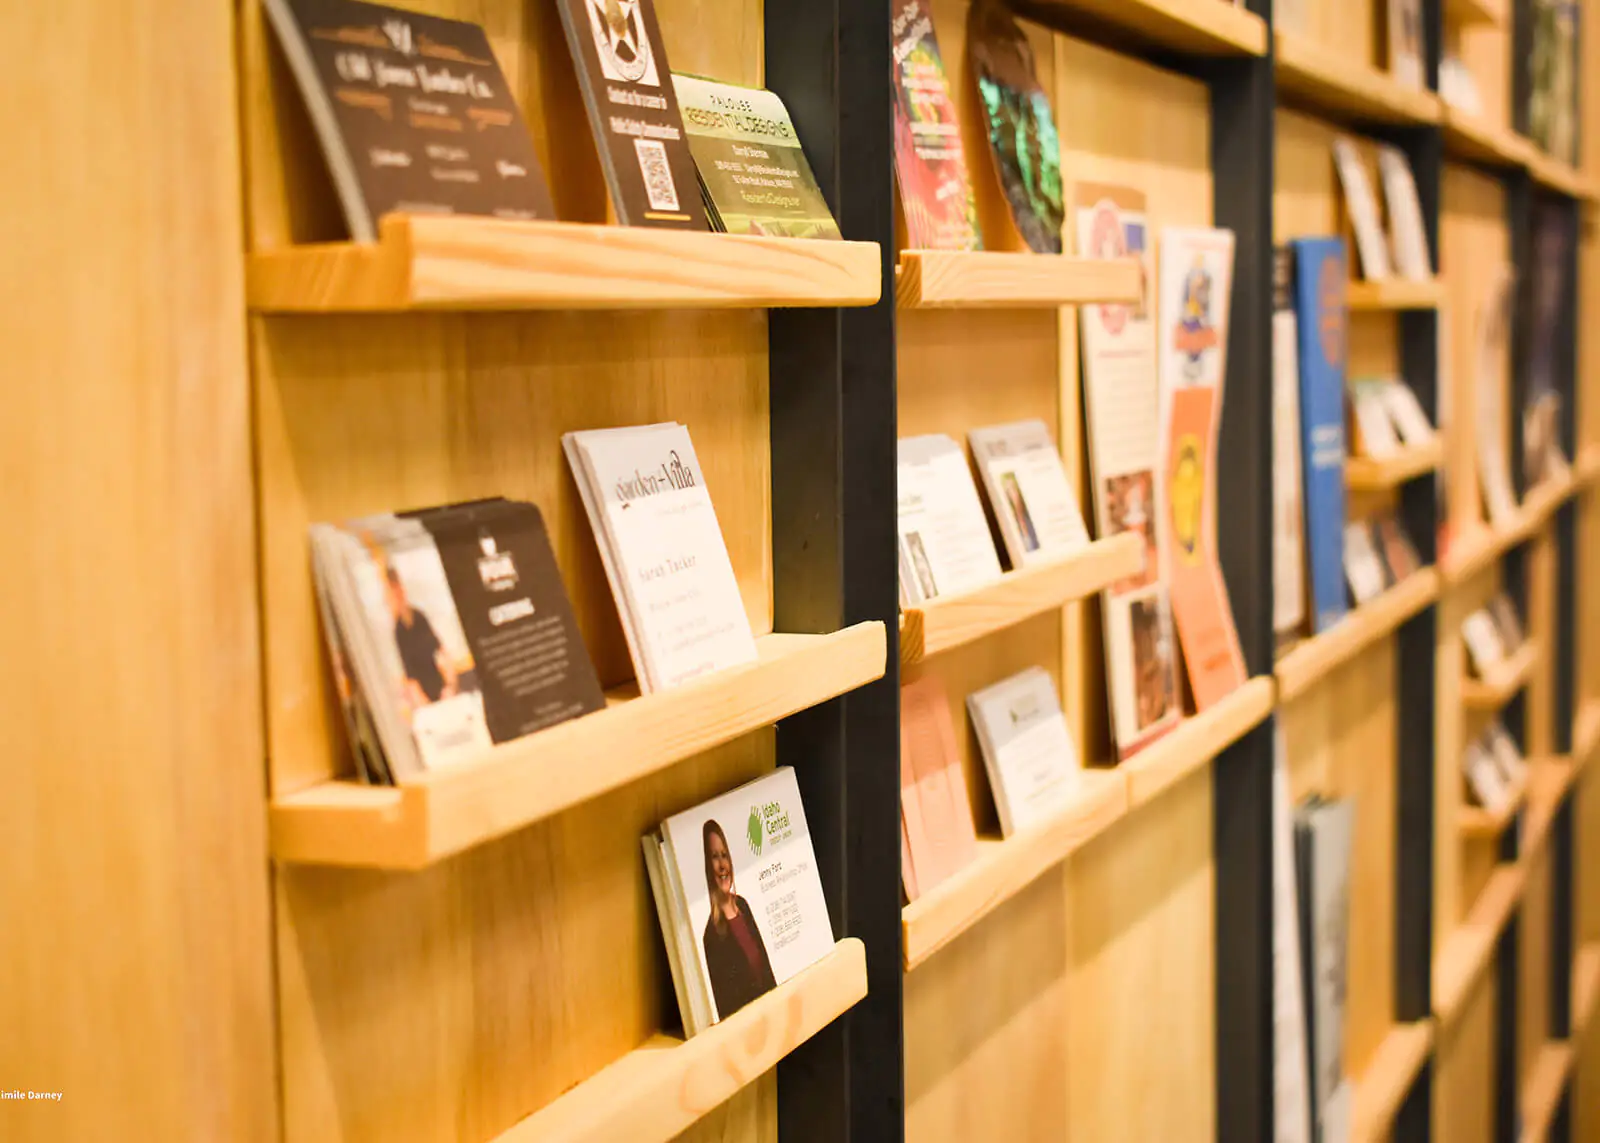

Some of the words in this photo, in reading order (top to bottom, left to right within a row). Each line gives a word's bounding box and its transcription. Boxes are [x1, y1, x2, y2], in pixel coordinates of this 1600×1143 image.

[710, 94, 752, 113] PALOUSE
[761, 800, 781, 820] Idaho
[766, 810, 791, 835] Central
